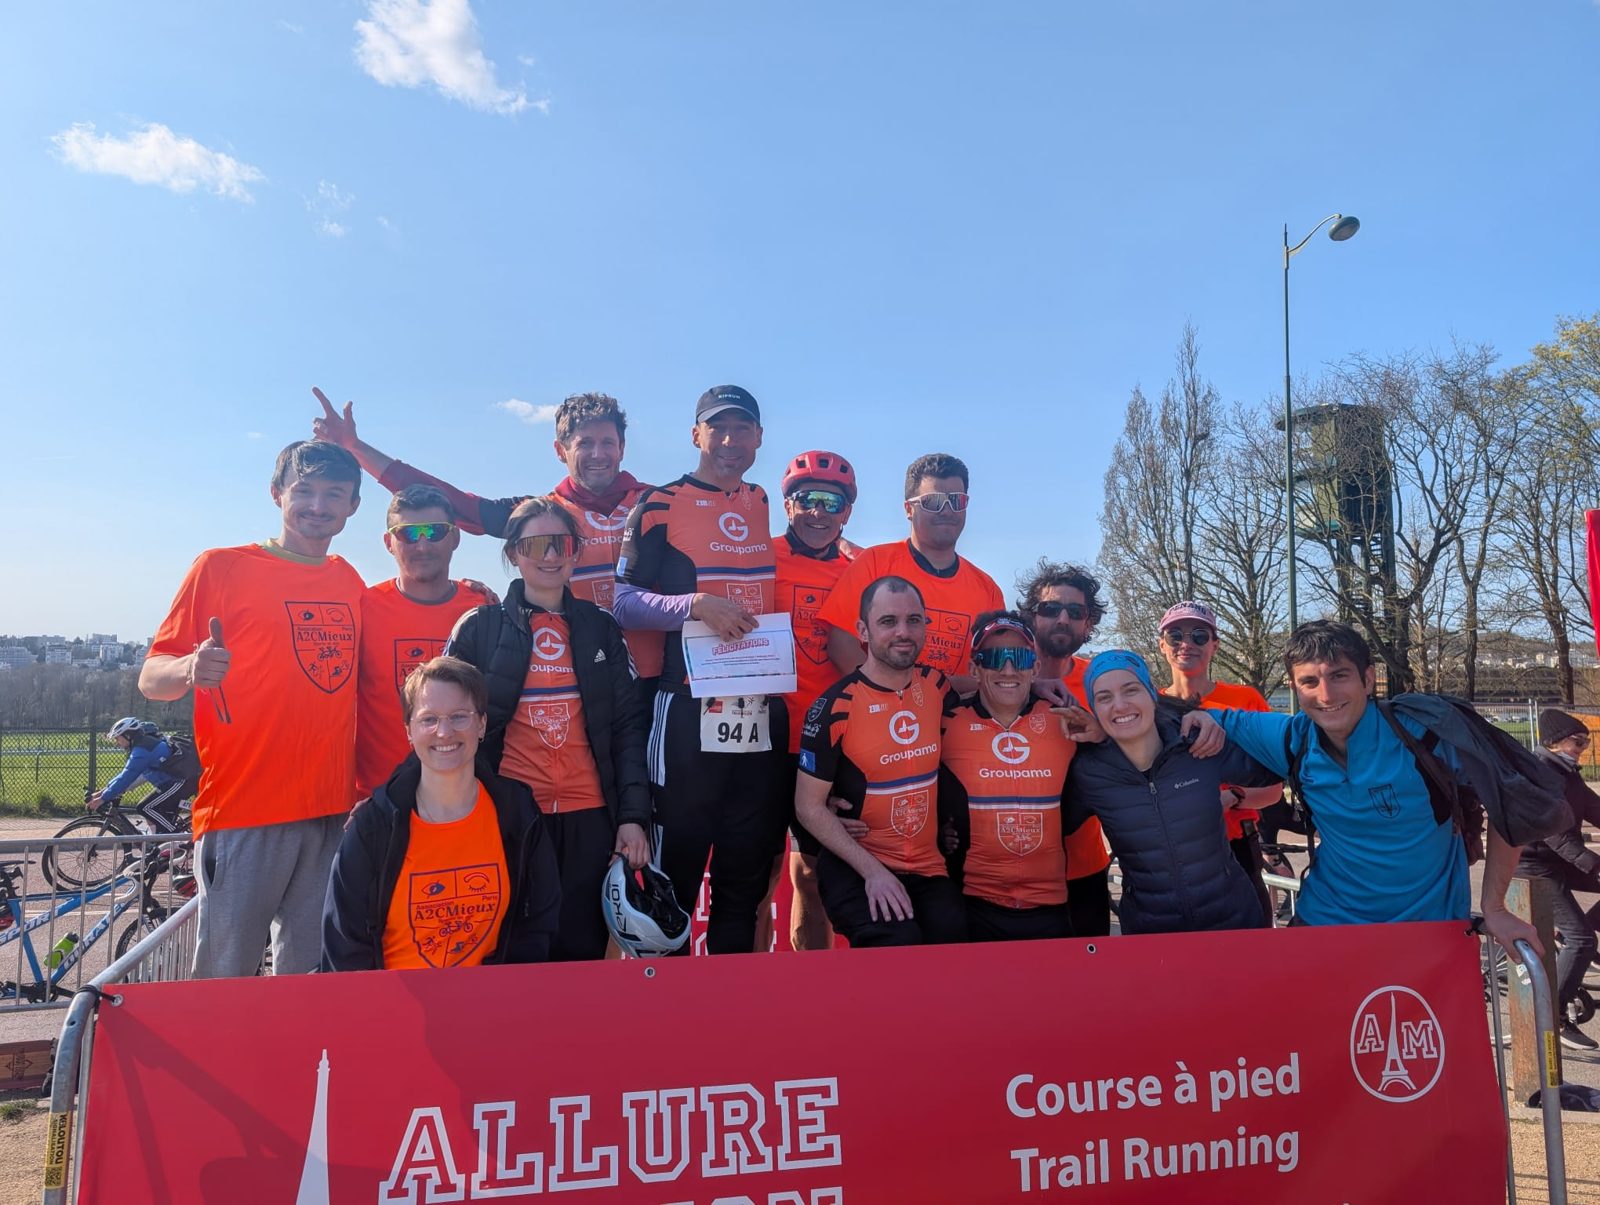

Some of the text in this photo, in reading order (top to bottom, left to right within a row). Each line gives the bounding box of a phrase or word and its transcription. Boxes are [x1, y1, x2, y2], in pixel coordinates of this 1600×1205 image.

[710, 541, 767, 555] Groupama
[297, 630, 353, 641] A2CMieux
[931, 636, 963, 649] Mieux
[712, 638, 769, 655] FÉLICITATIONS
[718, 722, 759, 743] 94 A
[880, 743, 937, 764] Groupama
[979, 768, 1052, 779] Groupama
[415, 903, 495, 921] A2CMieux
[1357, 1013, 1438, 1060] A M
[1006, 1052, 1300, 1118] Course à pied
[55, 1114, 67, 1165] KELOUTOU
[378, 1076, 842, 1205] ALLURE
[1010, 1126, 1299, 1192] Trail Running
